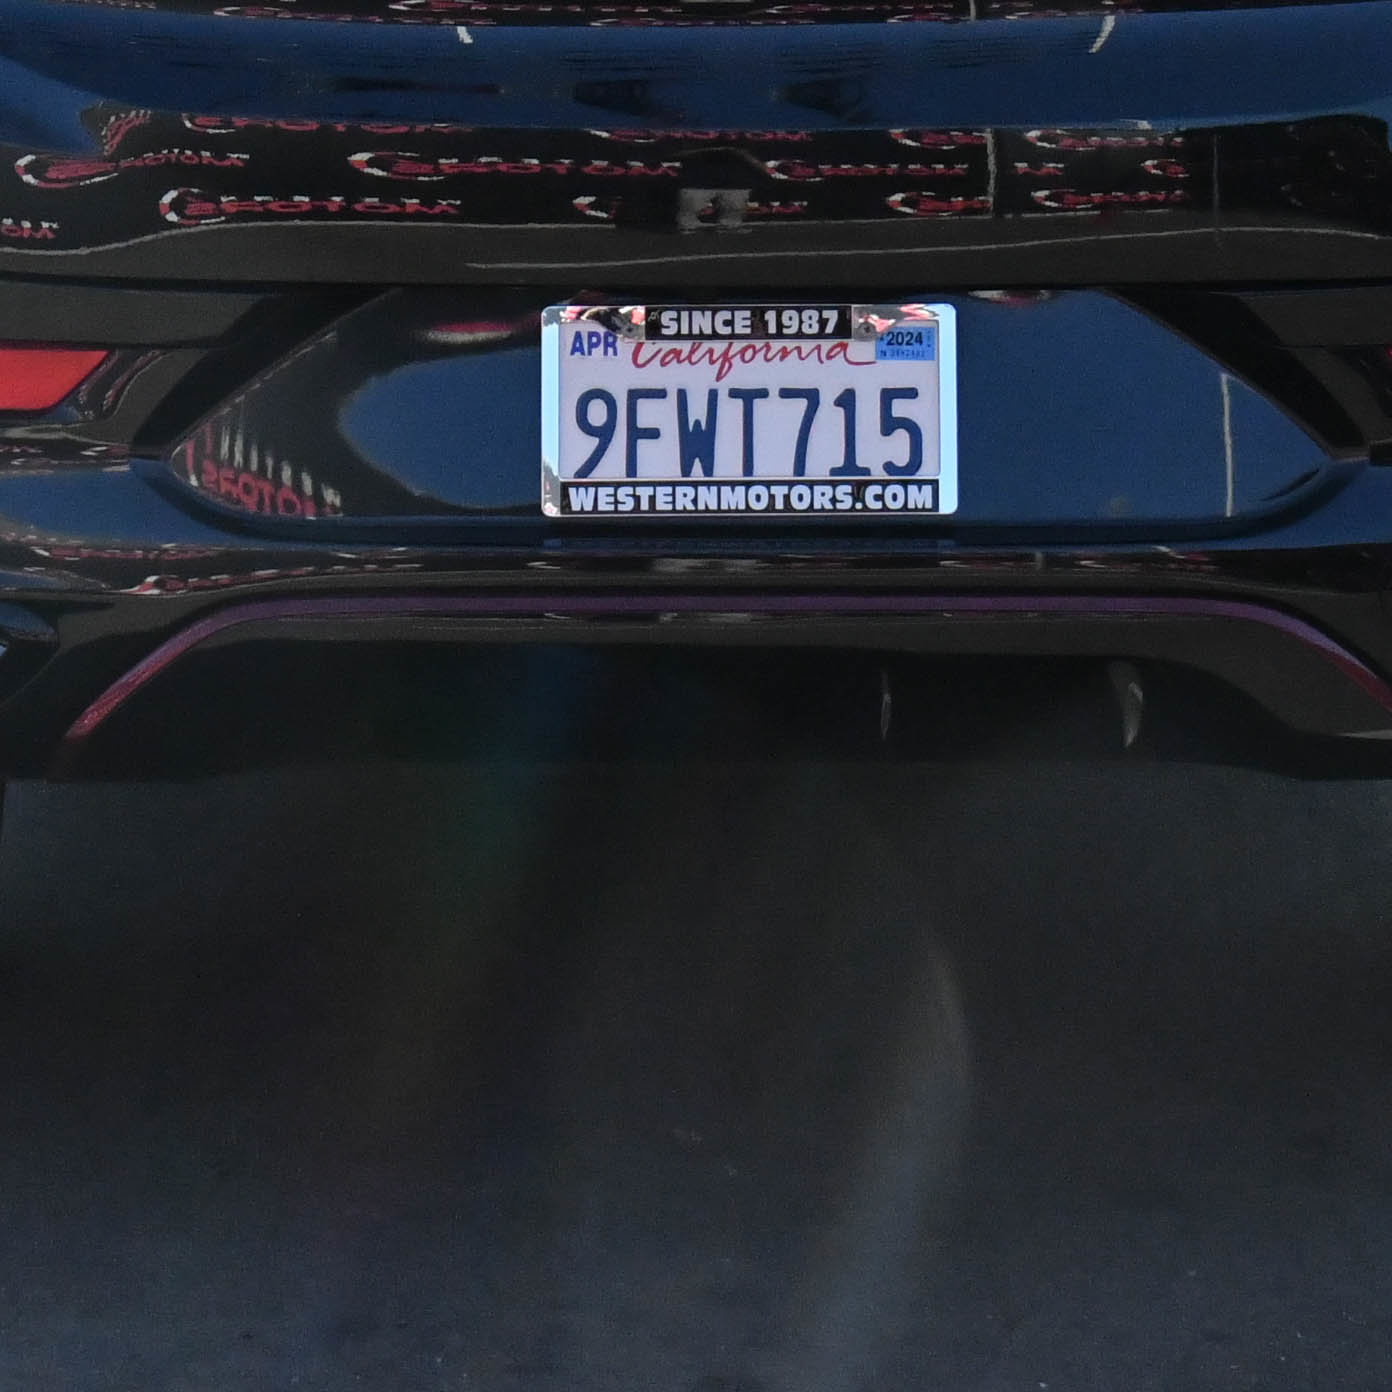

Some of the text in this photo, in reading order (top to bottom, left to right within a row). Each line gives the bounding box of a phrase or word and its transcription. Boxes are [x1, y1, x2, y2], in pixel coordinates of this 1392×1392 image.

[660, 310, 839, 335] SINCE 1987
[569, 331, 618, 357] APR
[886, 331, 924, 346] 2024
[630, 340, 877, 382] California
[573, 387, 924, 479] 9FWT715
[568, 484, 933, 512] WESTERNMOTORS.COM
